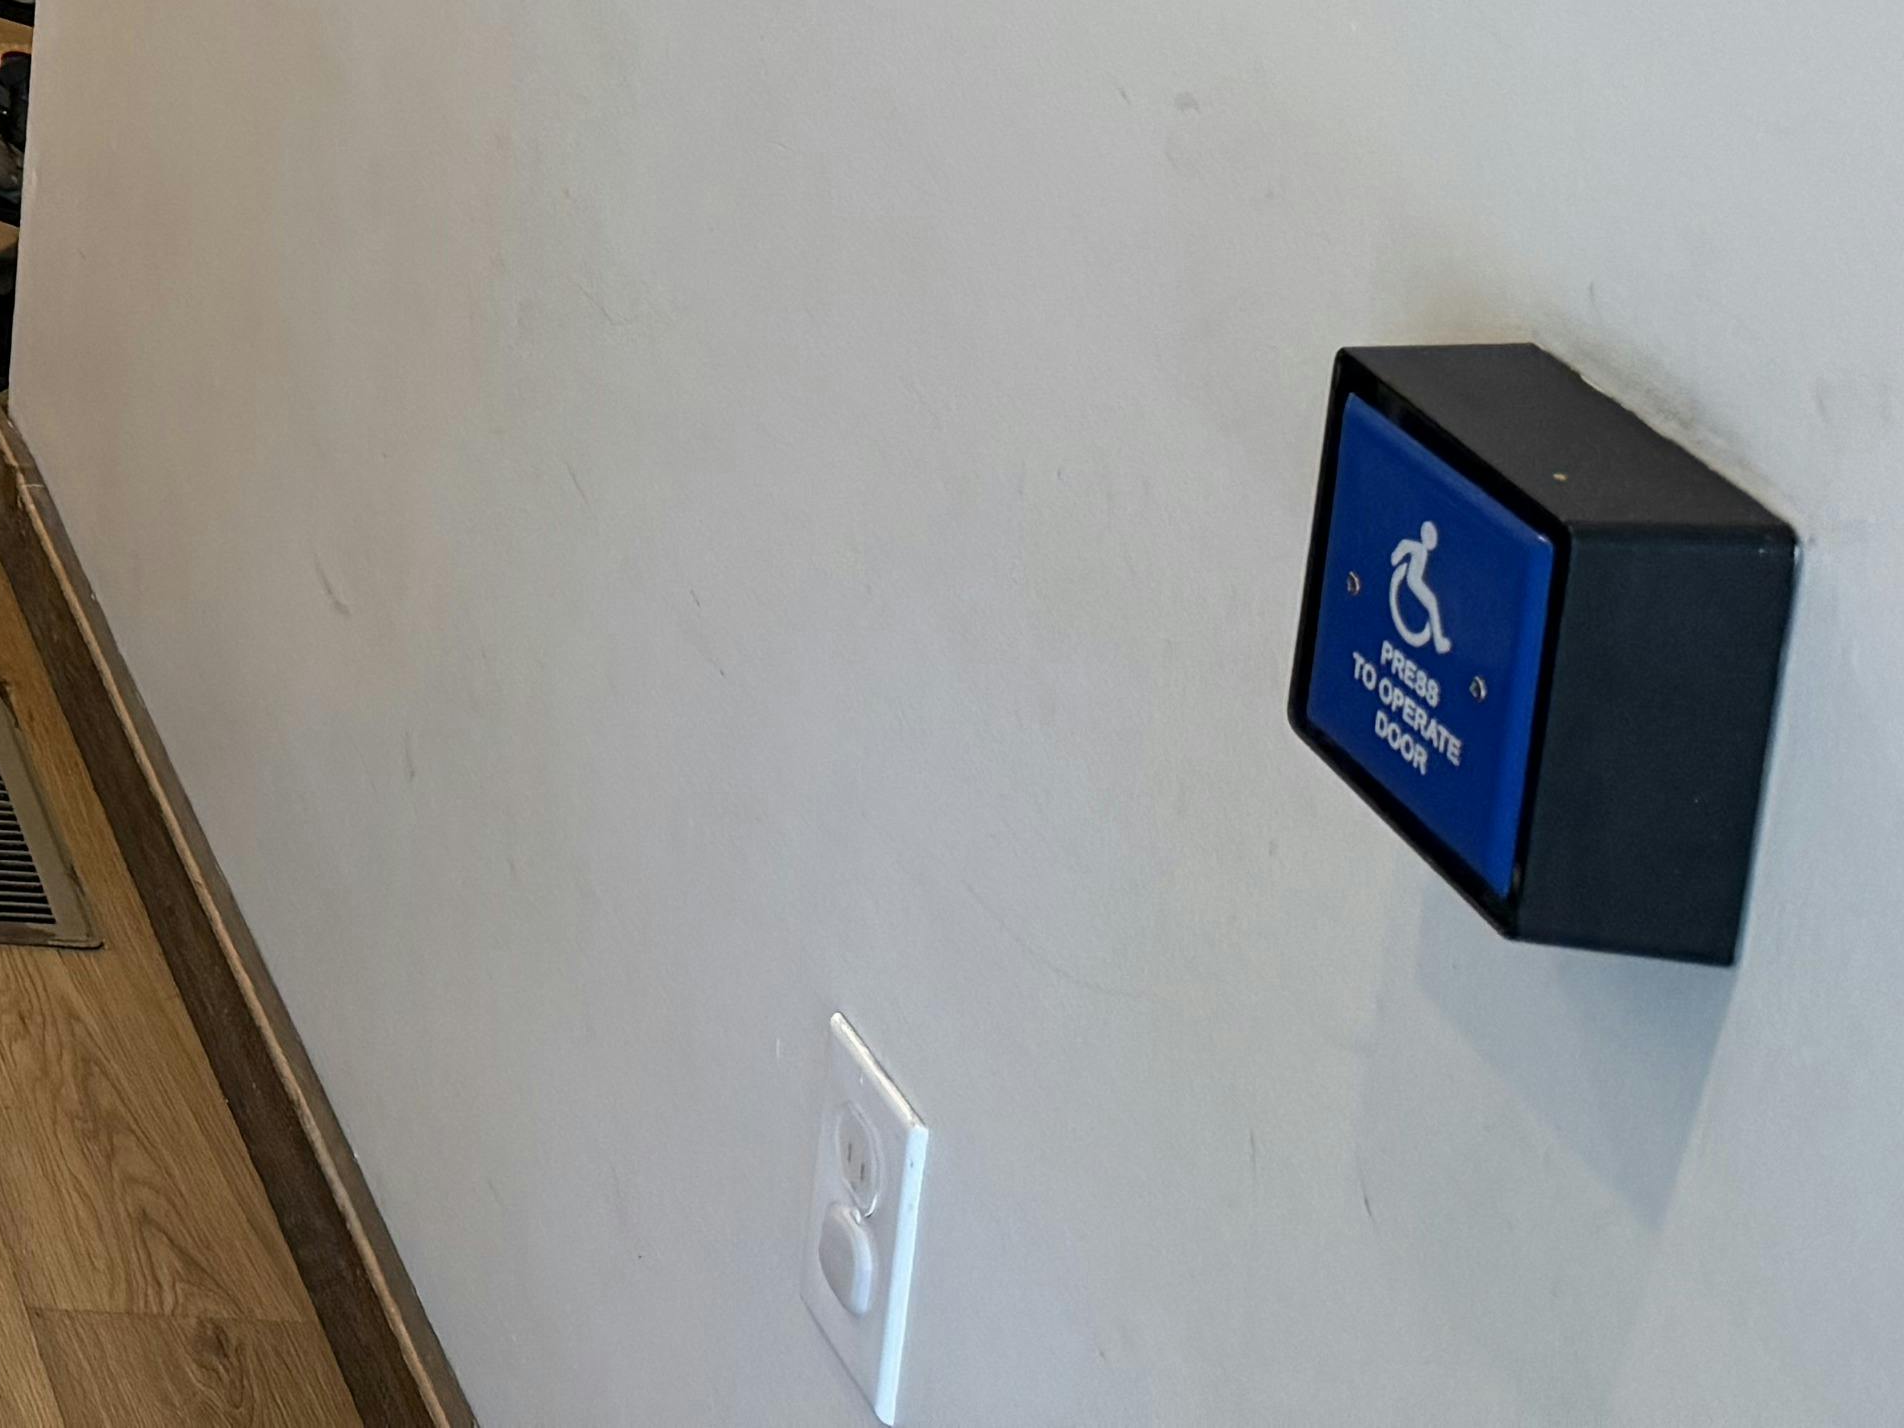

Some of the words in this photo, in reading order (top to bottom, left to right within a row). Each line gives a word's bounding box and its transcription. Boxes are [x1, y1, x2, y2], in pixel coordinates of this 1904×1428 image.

[1352, 651, 1377, 691] TO
[1378, 677, 1463, 767] OPERATE
[1381, 640, 1440, 709] PRESS
[1374, 710, 1429, 776] DOOR
